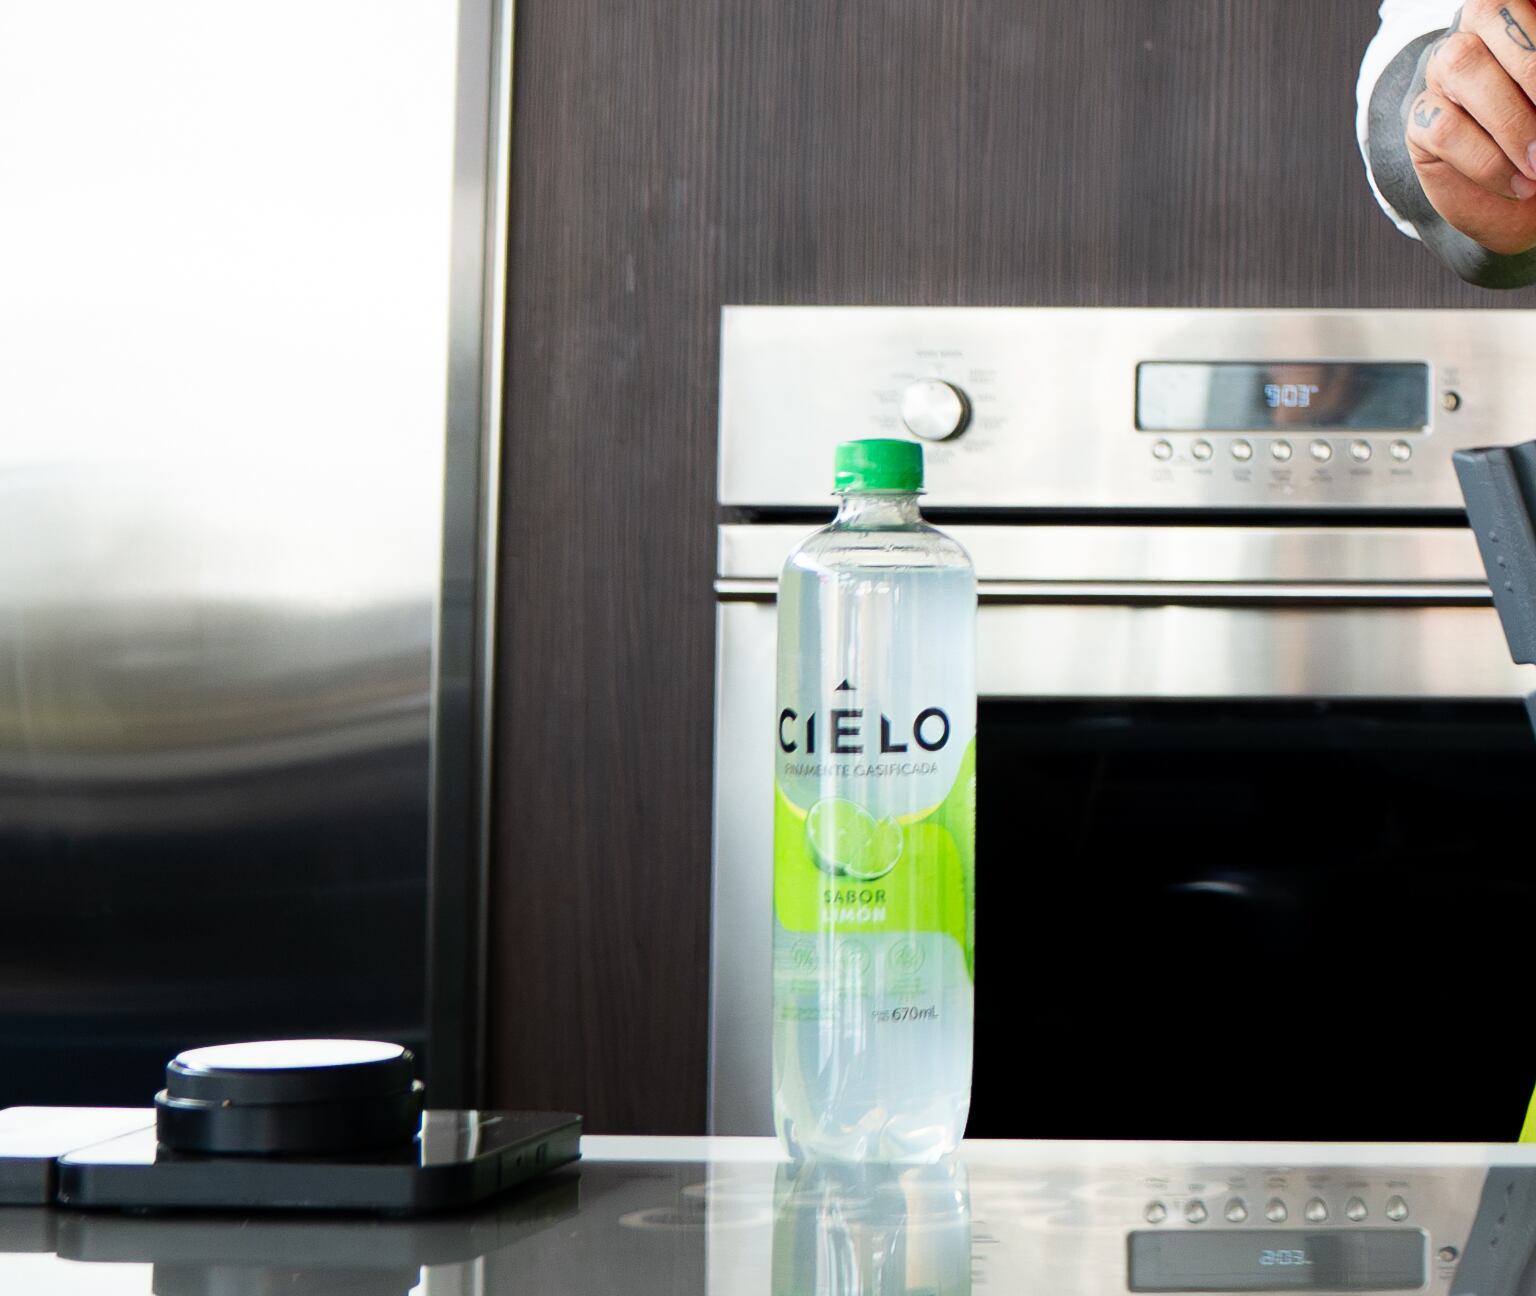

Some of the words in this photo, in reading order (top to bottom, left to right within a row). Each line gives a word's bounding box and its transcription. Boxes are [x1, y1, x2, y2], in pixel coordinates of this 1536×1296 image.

[853, 762, 939, 777] GASIFICADA
[823, 889, 887, 905] SABOR
[891, 1004, 940, 1021] 670mL
